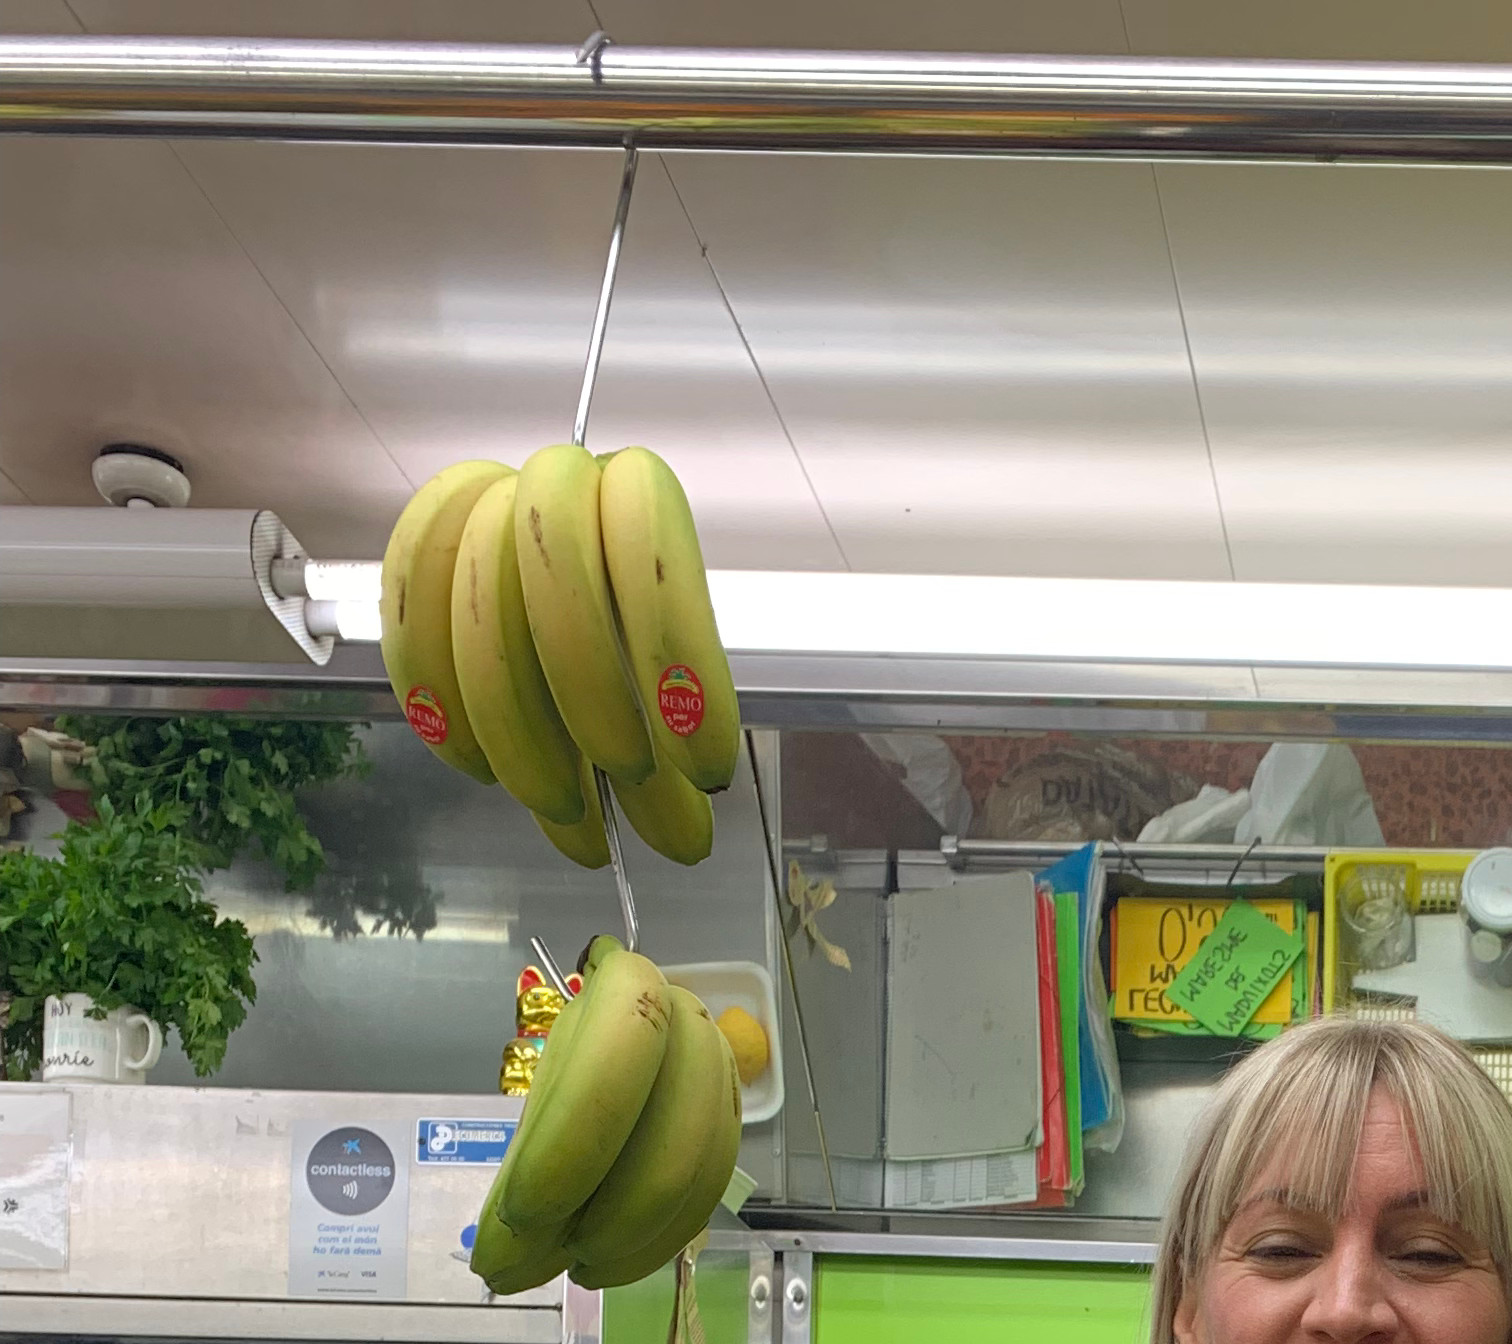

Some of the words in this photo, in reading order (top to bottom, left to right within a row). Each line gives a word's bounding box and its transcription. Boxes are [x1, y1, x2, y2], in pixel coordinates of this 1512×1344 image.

[660, 693, 701, 711] REMO
[408, 705, 446, 731] REMO
[310, 1162, 392, 1178] contactless
[317, 1223, 353, 1236] Compri
[356, 1223, 380, 1235] avui
[318, 1236, 340, 1245] com
[312, 1245, 326, 1255] ho
